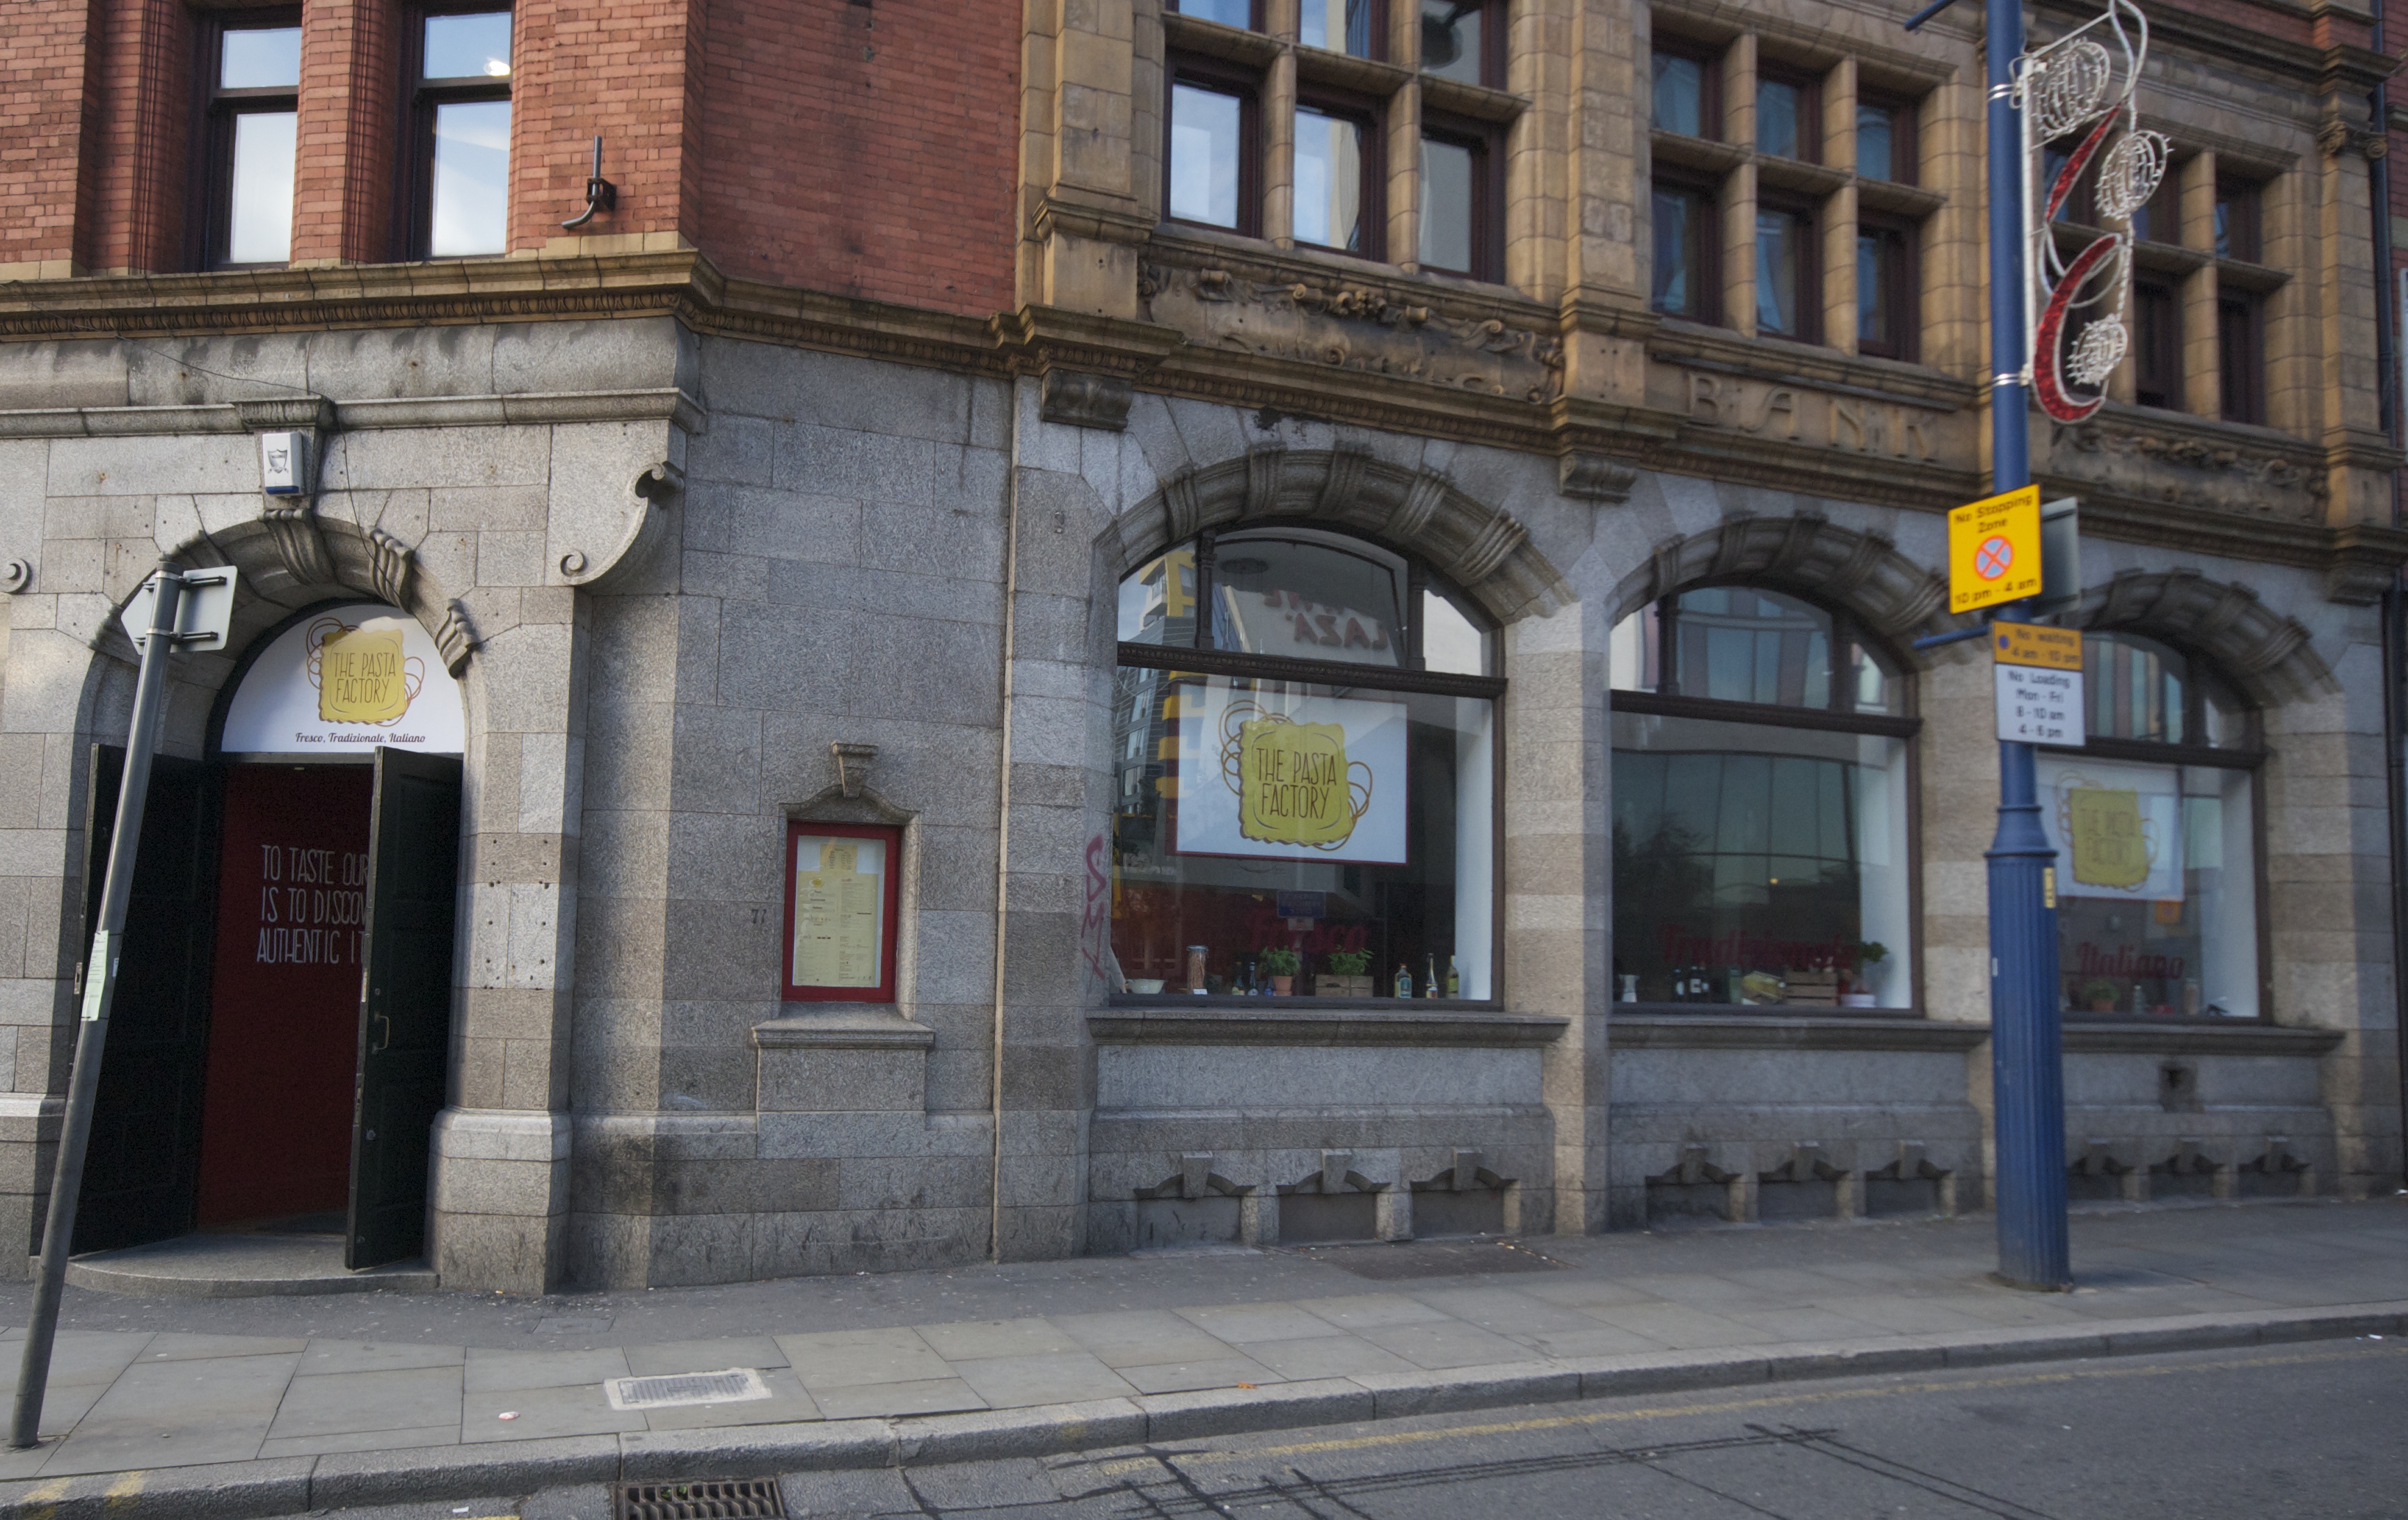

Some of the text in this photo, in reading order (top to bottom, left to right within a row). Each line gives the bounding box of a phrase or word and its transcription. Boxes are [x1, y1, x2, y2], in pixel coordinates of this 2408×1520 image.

[1955, 495, 2032, 523] No Stopping
[1978, 518, 2007, 533] Zone
[1955, 593, 1969, 604] 10
[1973, 589, 1993, 602] pm
[2004, 582, 2013, 592] 4
[2018, 578, 2036, 590] am
[333, 652, 396, 678] THE PASTA
[335, 678, 390, 704] FACTORY
[2008, 670, 2071, 689] No Loading
[2017, 688, 2039, 701] Mon
[2049, 711, 2065, 720] am
[295, 732, 426, 744] Fresco, Tradizionale, Italiano
[1256, 747, 1337, 786] THE PASTA
[1261, 782, 1330, 819] FACTORY
[262, 844, 369, 886] TO TASTE OUR
[261, 886, 278, 923] IS
[287, 887, 307, 923] TO
[257, 927, 341, 965] AUTHENTIC
